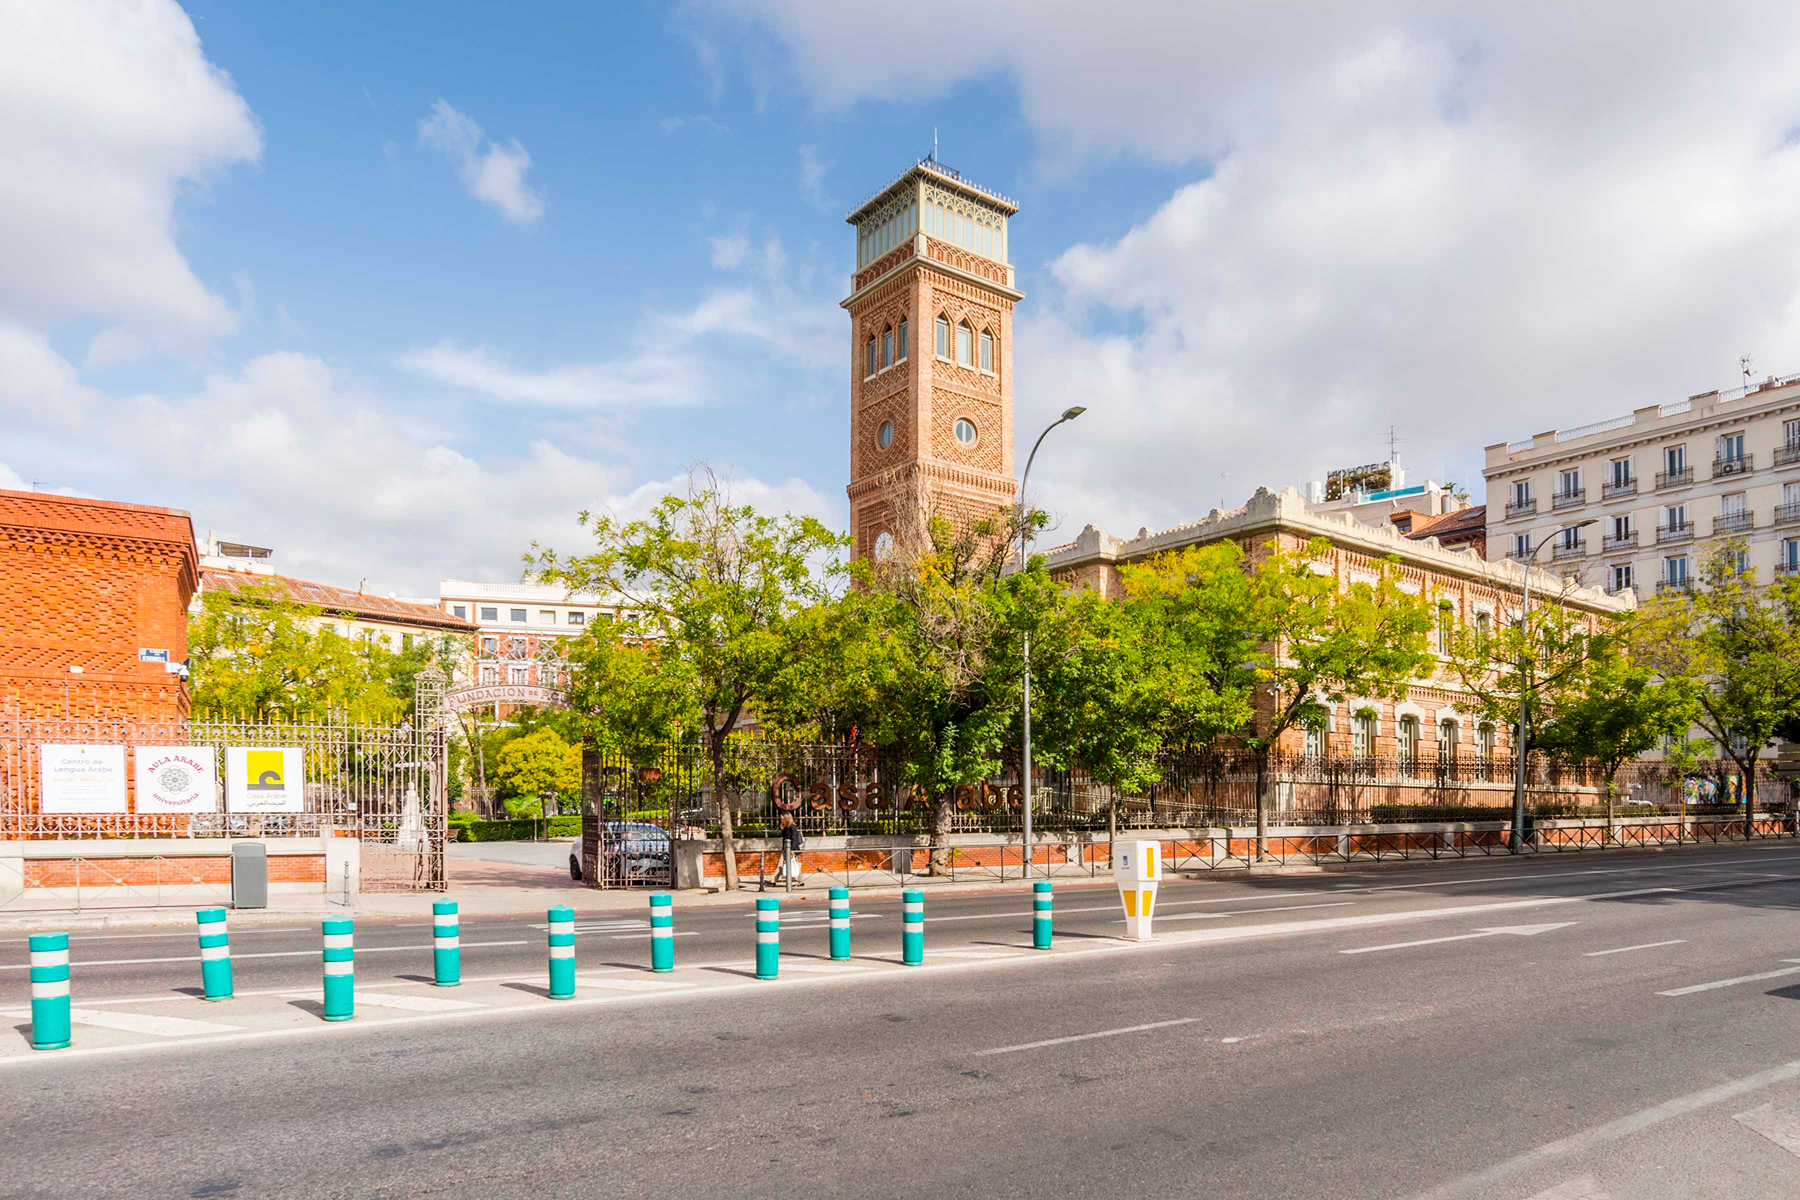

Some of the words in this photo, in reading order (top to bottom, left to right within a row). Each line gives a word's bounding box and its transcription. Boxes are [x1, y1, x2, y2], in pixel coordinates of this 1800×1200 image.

[1347, 461, 1390, 477] HOTELS
[447, 687, 525, 708] FUNDACION
[54, 766, 85, 774] Lengua
[148, 756, 171, 774] AULA
[173, 755, 205, 774] ARABE
[152, 792, 200, 806] universitaria
[771, 773, 889, 812] Casa
[904, 776, 1024, 811] Aabe
